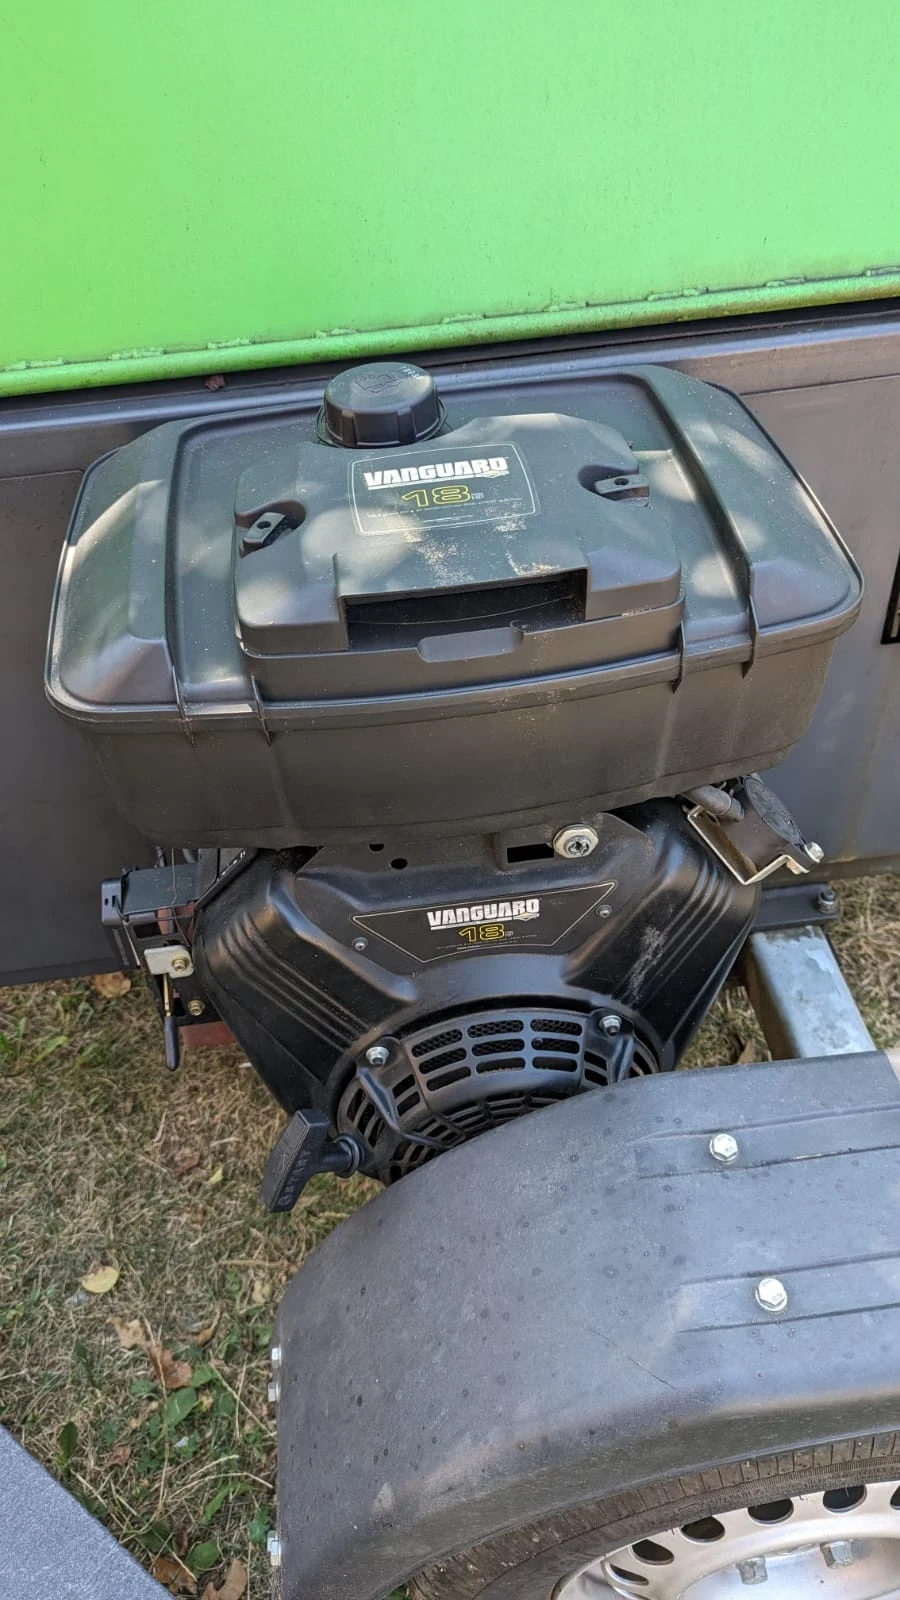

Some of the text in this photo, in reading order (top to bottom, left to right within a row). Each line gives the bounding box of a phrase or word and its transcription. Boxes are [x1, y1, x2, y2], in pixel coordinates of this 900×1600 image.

[364, 457, 509, 487] VANGUARD
[402, 485, 472, 507] 18
[427, 898, 540, 926] VANGUARD
[459, 923, 505, 942] 18
